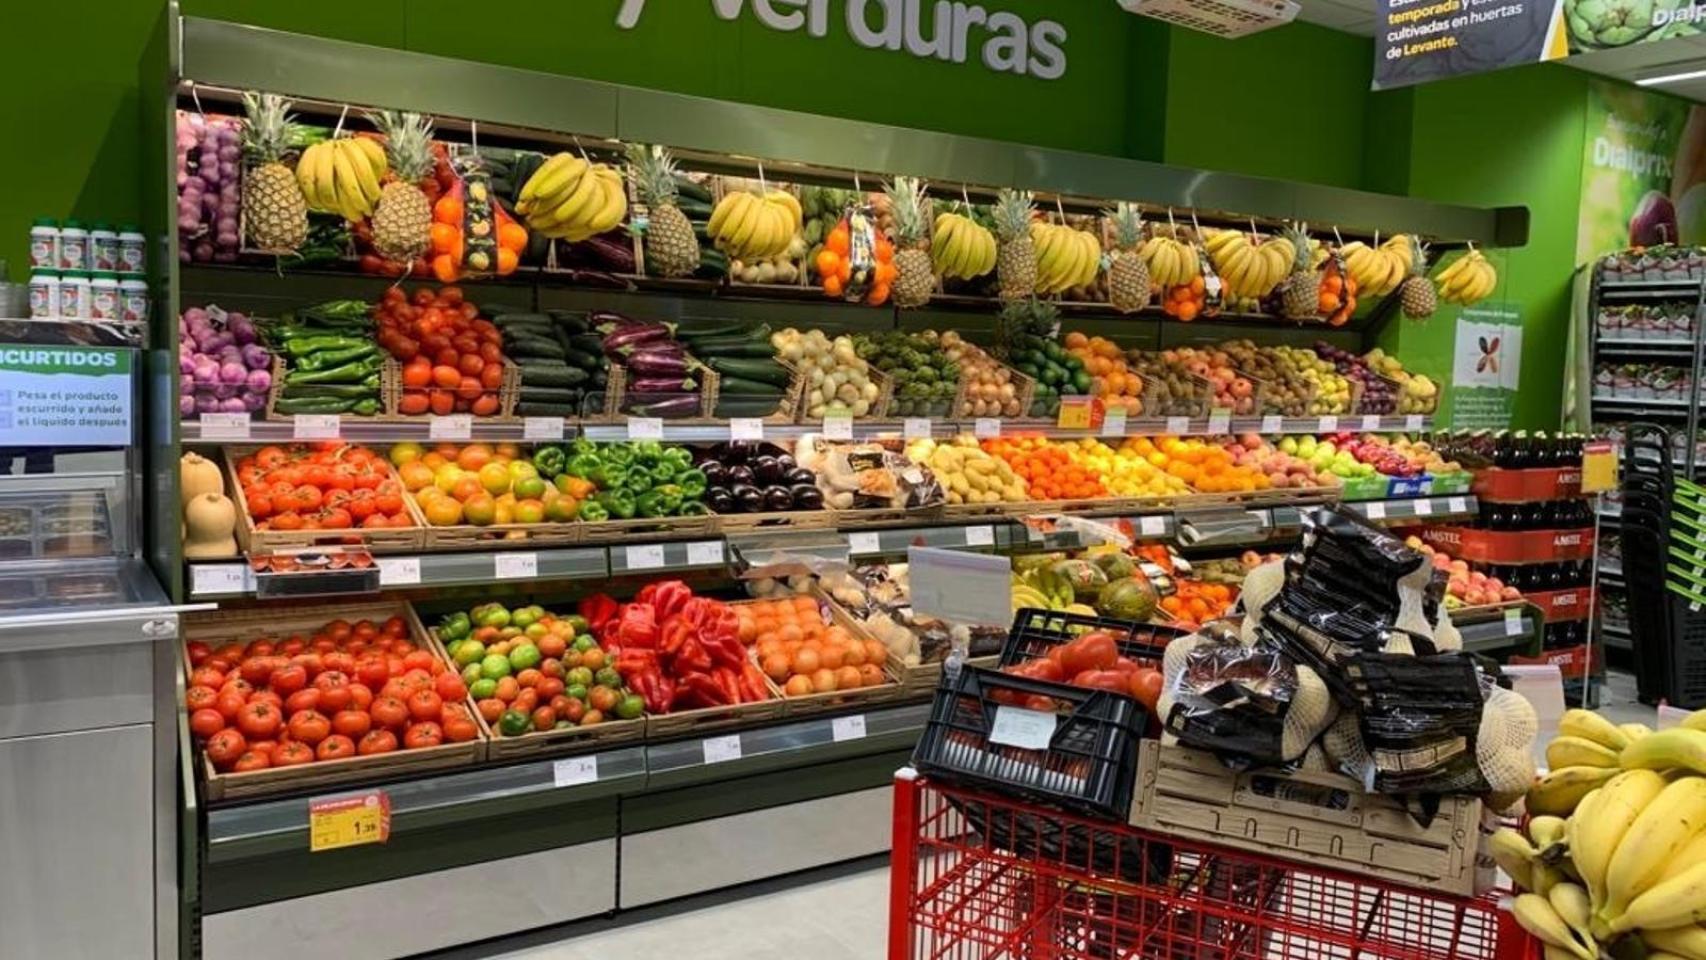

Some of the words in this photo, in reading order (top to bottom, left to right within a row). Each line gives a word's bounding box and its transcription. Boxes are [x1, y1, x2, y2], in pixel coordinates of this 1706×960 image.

[1388, 1, 1460, 25] temporada
[1387, 19, 1449, 42] cultivadas
[1452, 15, 1468, 28] en
[1470, 4, 1523, 24] huertas
[1386, 47, 1401, 59] de
[1404, 36, 1458, 56] Levante.
[1593, 137, 1672, 180] Dialprix
[17, 391, 47, 399] Pesa
[65, 391, 118, 401] producto
[18, 404, 75, 413] escurrido
[79, 406, 85, 414] y
[17, 417, 29, 425] el
[1422, 529, 1462, 545] AMSTEL
